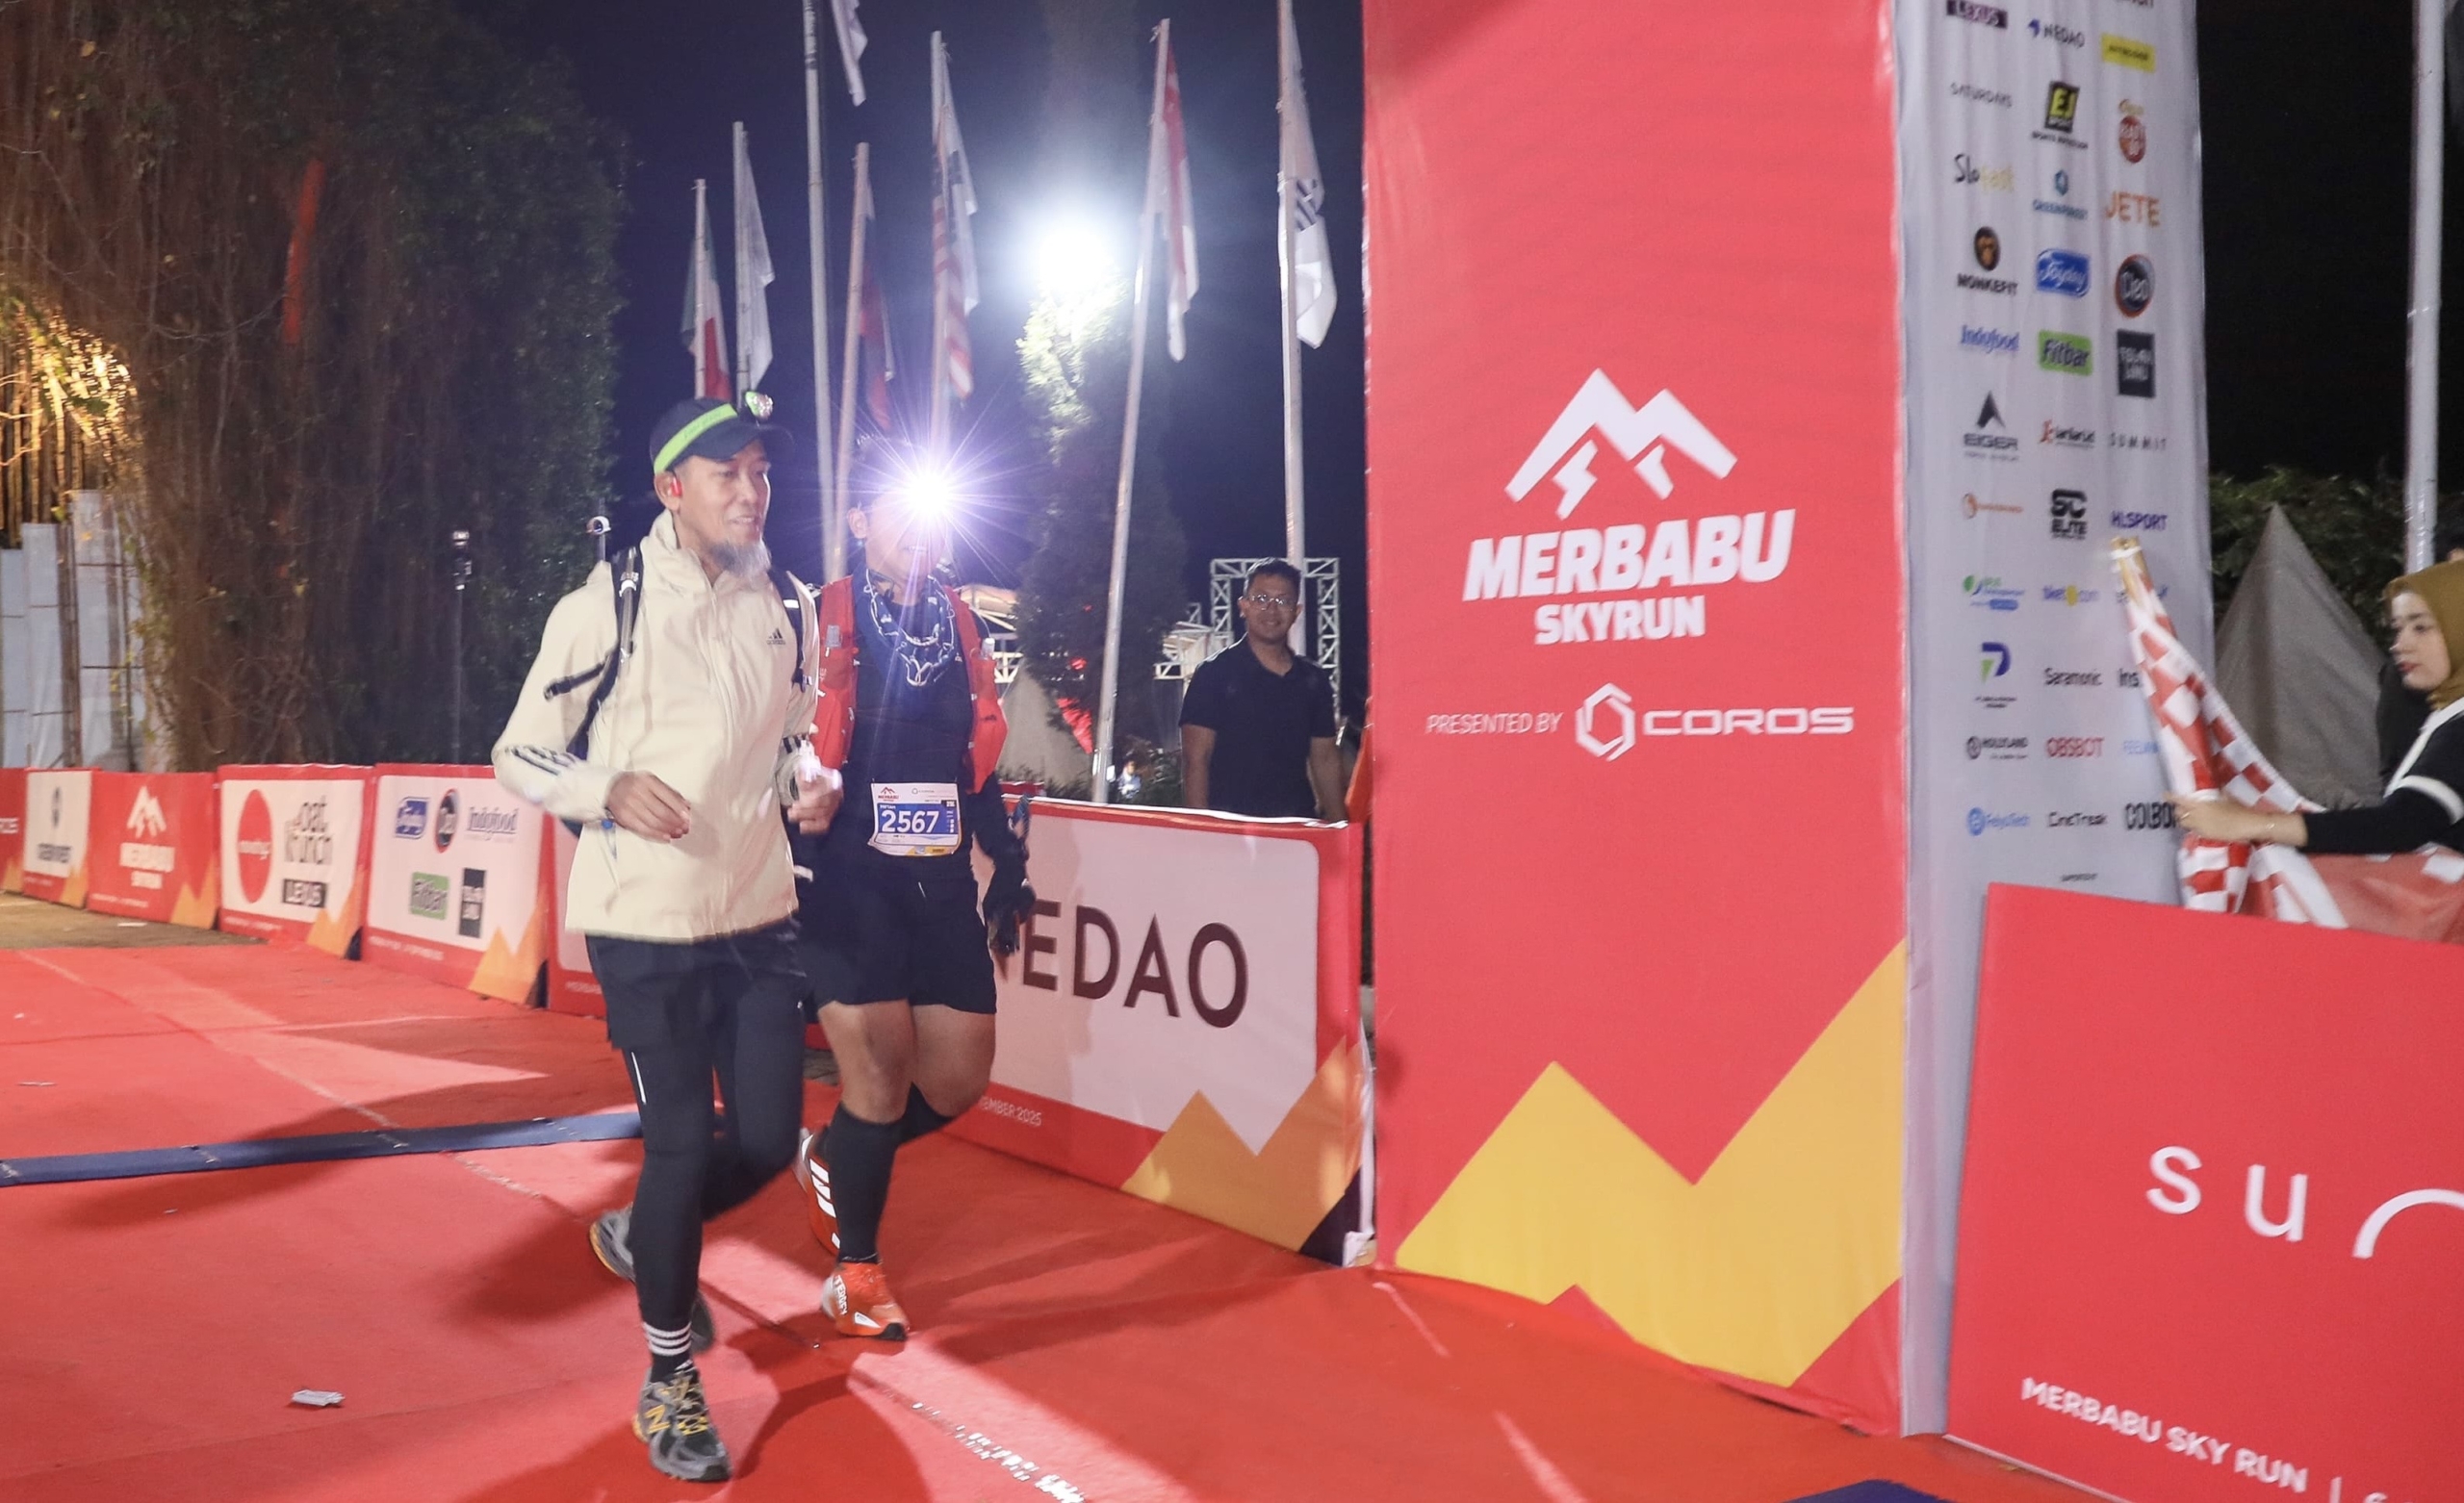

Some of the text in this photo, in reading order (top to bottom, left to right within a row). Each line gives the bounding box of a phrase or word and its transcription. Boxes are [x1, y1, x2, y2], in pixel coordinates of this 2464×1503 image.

[1958, 1, 2001, 26] LEXUS
[2043, 24, 2086, 49] NEDAO
[1950, 83, 2013, 109] SATURDAYS
[2105, 191, 2161, 228] JETE
[1957, 273, 2017, 296] MONKEFIT
[1961, 325, 2019, 354] Indofood
[2042, 339, 2090, 368] Fitbar
[1964, 433, 2018, 451] EIGER
[2110, 432, 2167, 451] SUMMIT
[2051, 519, 2088, 536] ELITE
[1462, 508, 1796, 601] MERBABU
[1534, 595, 1706, 645] SKYRUN
[2043, 667, 2103, 687] Saramonic
[1424, 711, 1565, 735] PRESENTED BY
[1643, 706, 1854, 735] COROS
[2046, 736, 2104, 758] OBSBOT
[881, 809, 940, 833] 2567
[991, 899, 1249, 1029] EDAO
[1016, 1107, 1043, 1127] 2025
[2021, 1377, 2309, 1493] MERBABU SKY RUN
